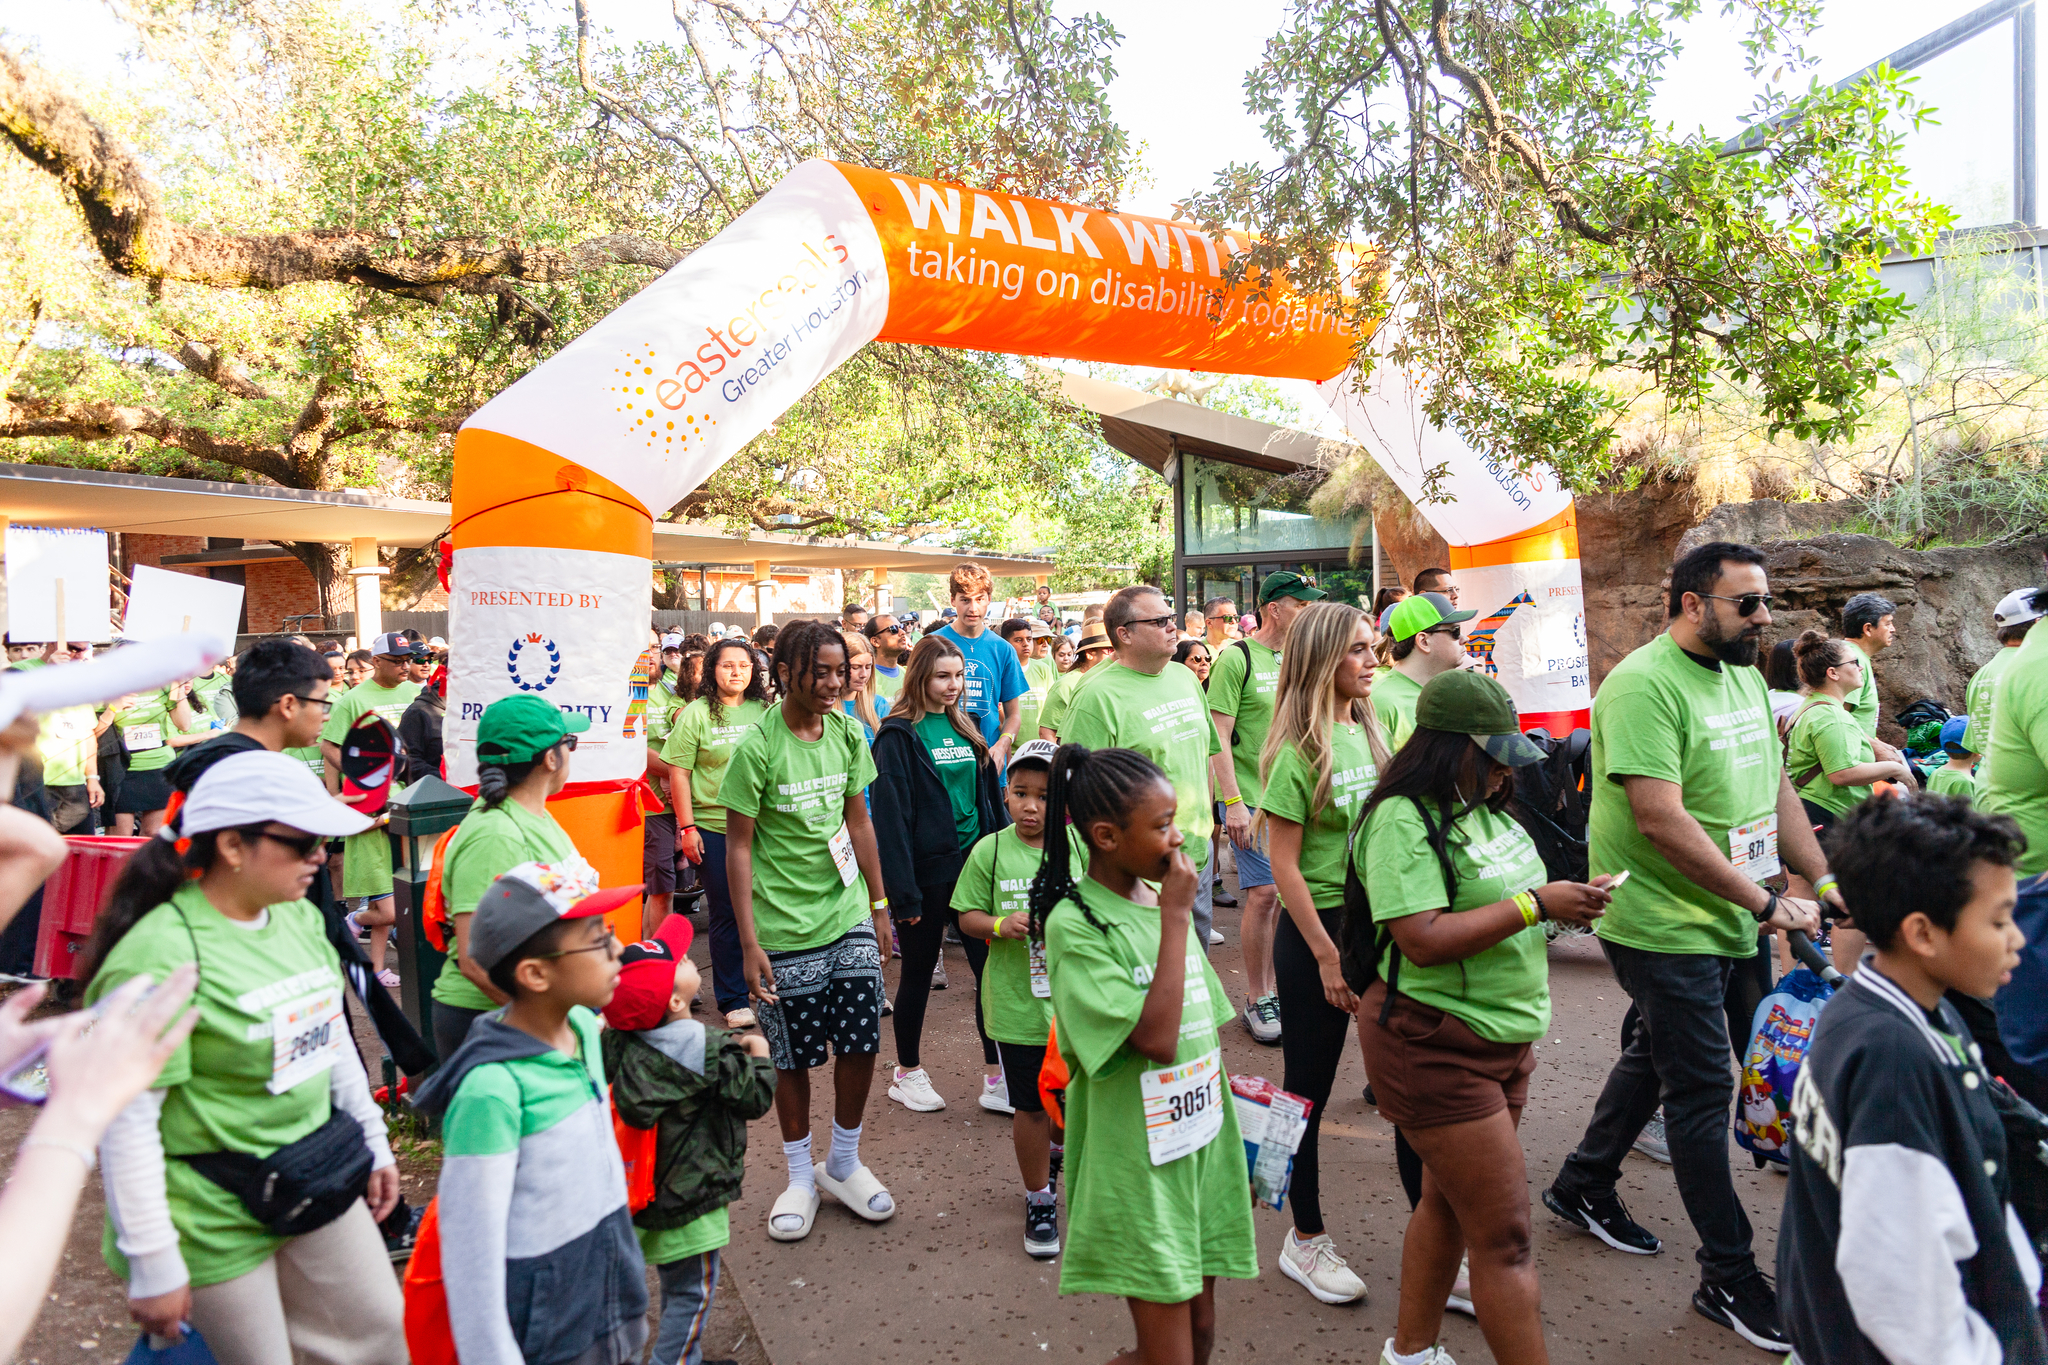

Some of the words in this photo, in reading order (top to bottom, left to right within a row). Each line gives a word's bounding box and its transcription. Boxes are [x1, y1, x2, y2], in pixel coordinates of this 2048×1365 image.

[889, 177, 1104, 259] WALK
[907, 240, 1025, 300] taking
[1036, 268, 1080, 300] on
[1243, 294, 1357, 337] togethe
[656, 234, 849, 411] easterseals
[722, 334, 793, 403] Greater
[791, 269, 869, 342] Houston
[1479, 448, 1532, 512] Houston
[471, 591, 574, 607] PRESENTED
[579, 594, 603, 609] BY
[777, 779, 813, 796] WALK
[776, 803, 799, 812] HELP.
[801, 798, 823, 810] HOPE.
[1748, 837, 1765, 861] 871
[1001, 900, 1019, 911] HELP.
[1158, 1067, 1186, 1085] WALK
[1186, 1061, 1206, 1077] WITH
[1169, 1081, 1212, 1122] 3051
